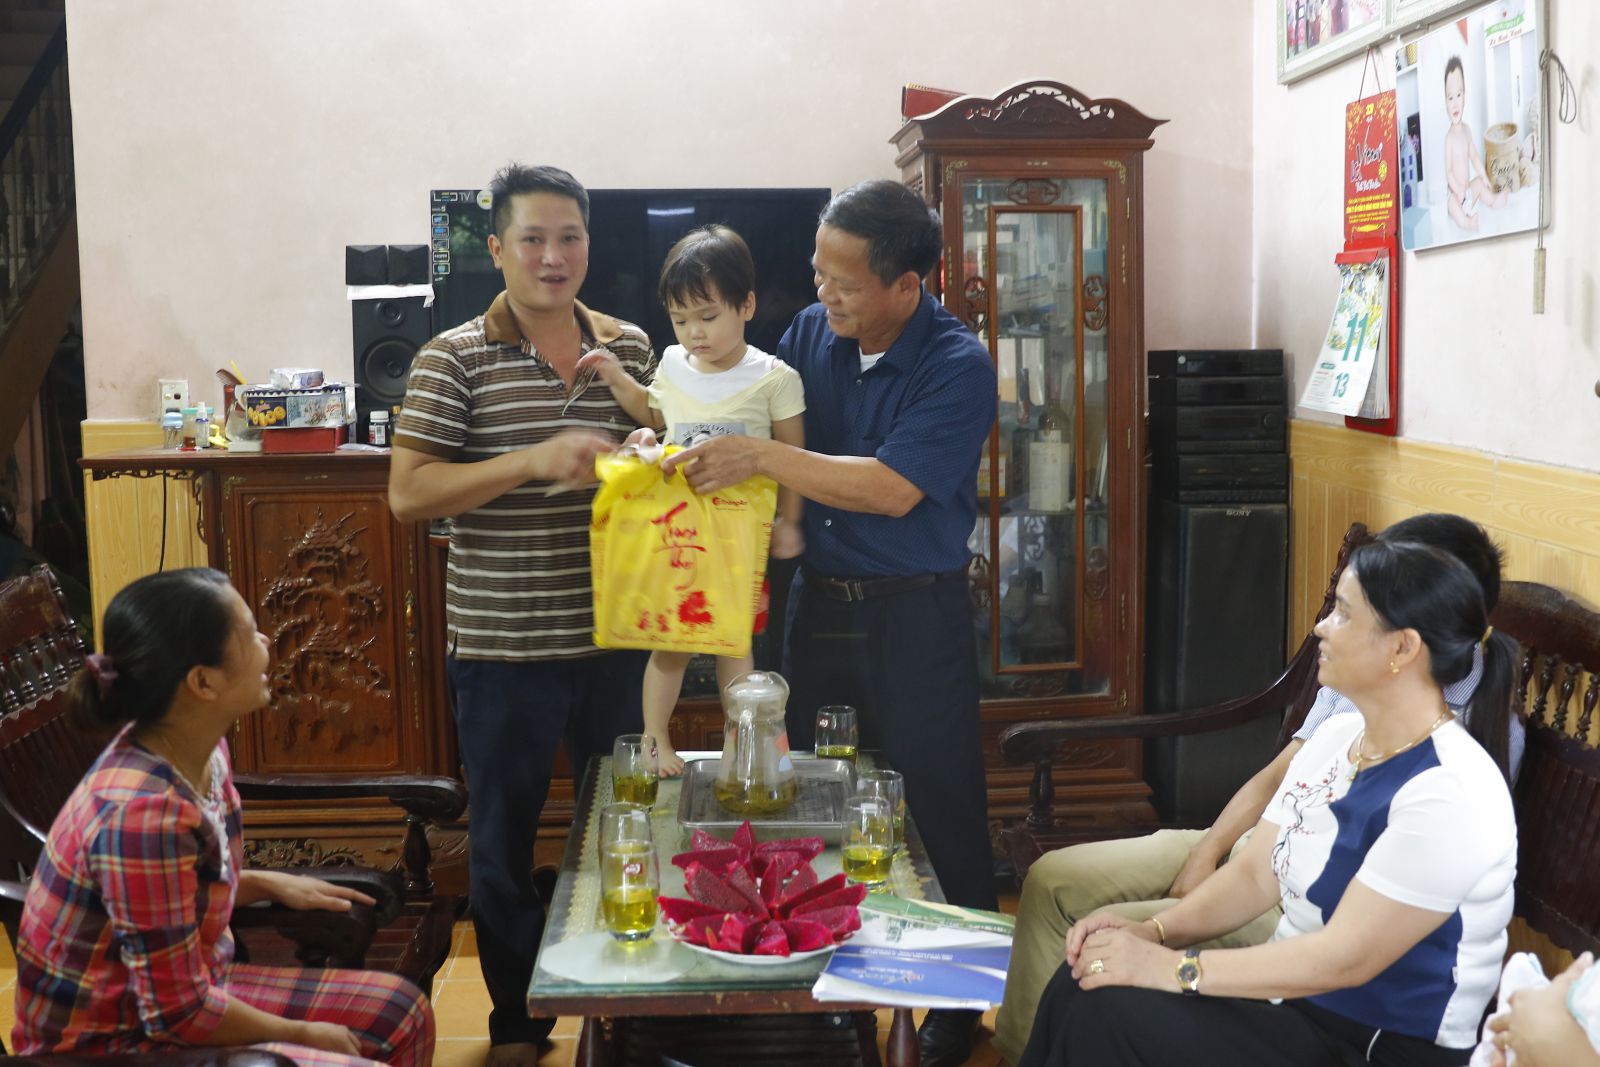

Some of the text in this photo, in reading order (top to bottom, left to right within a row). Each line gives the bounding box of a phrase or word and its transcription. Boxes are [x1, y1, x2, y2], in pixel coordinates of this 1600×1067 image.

[459, 191, 471, 201] TV
[1342, 312, 1369, 362] 11
[1332, 371, 1351, 398] 13
[1226, 509, 1252, 517] SONY
